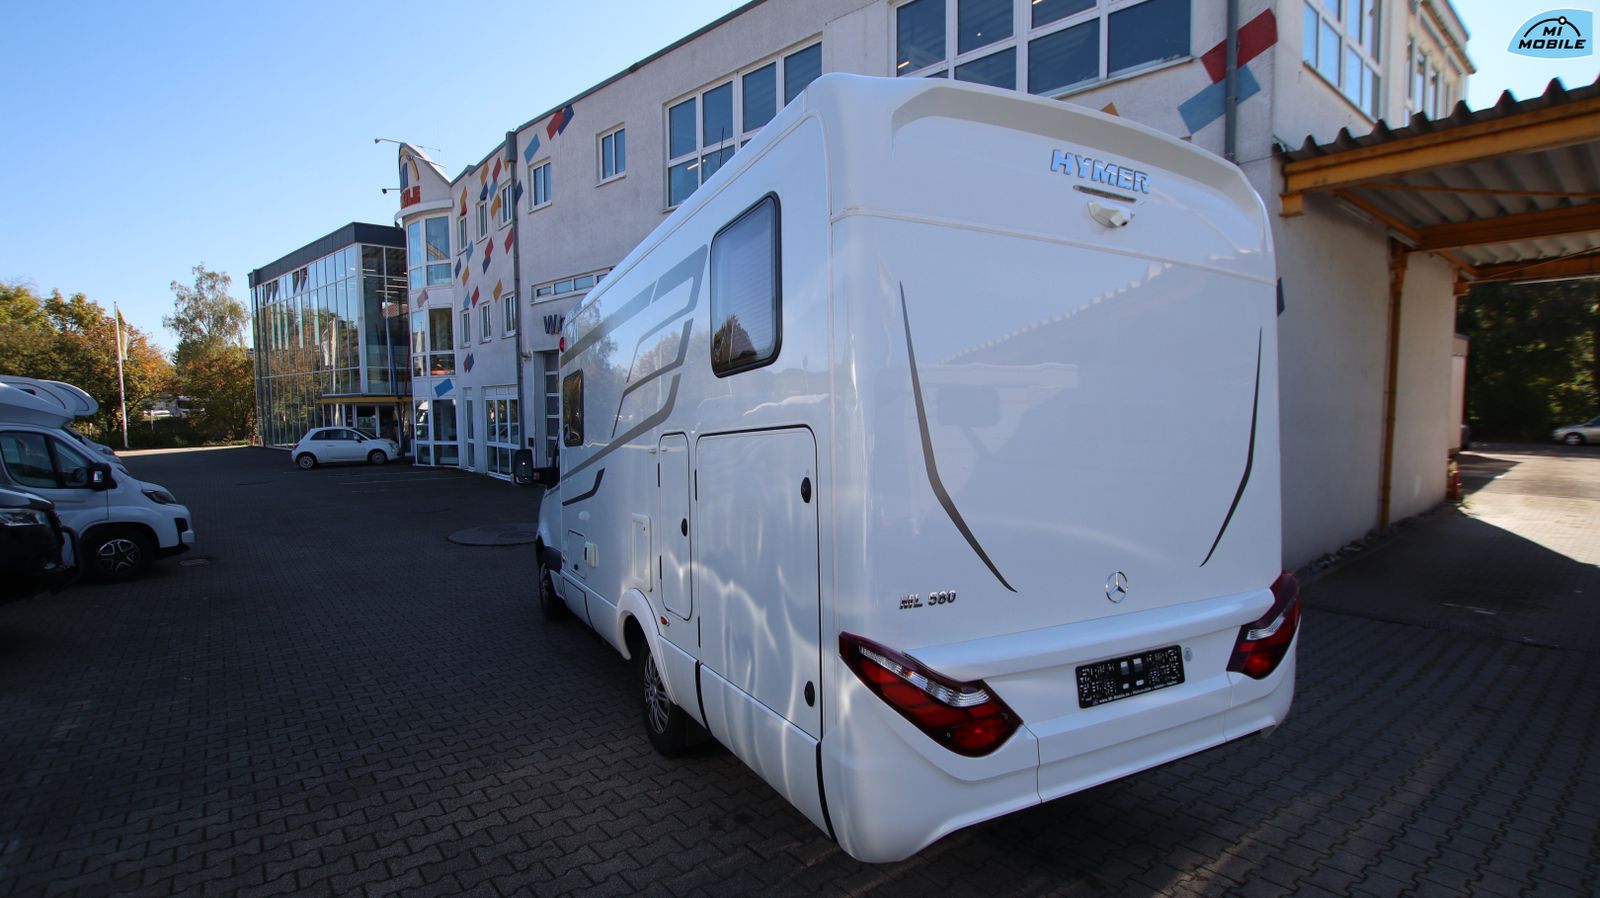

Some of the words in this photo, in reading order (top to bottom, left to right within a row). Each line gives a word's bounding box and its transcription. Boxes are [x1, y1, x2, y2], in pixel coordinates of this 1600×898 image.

[1050, 148, 1152, 194] HYMER
[899, 593, 923, 610] ML
[928, 590, 957, 606] 580
